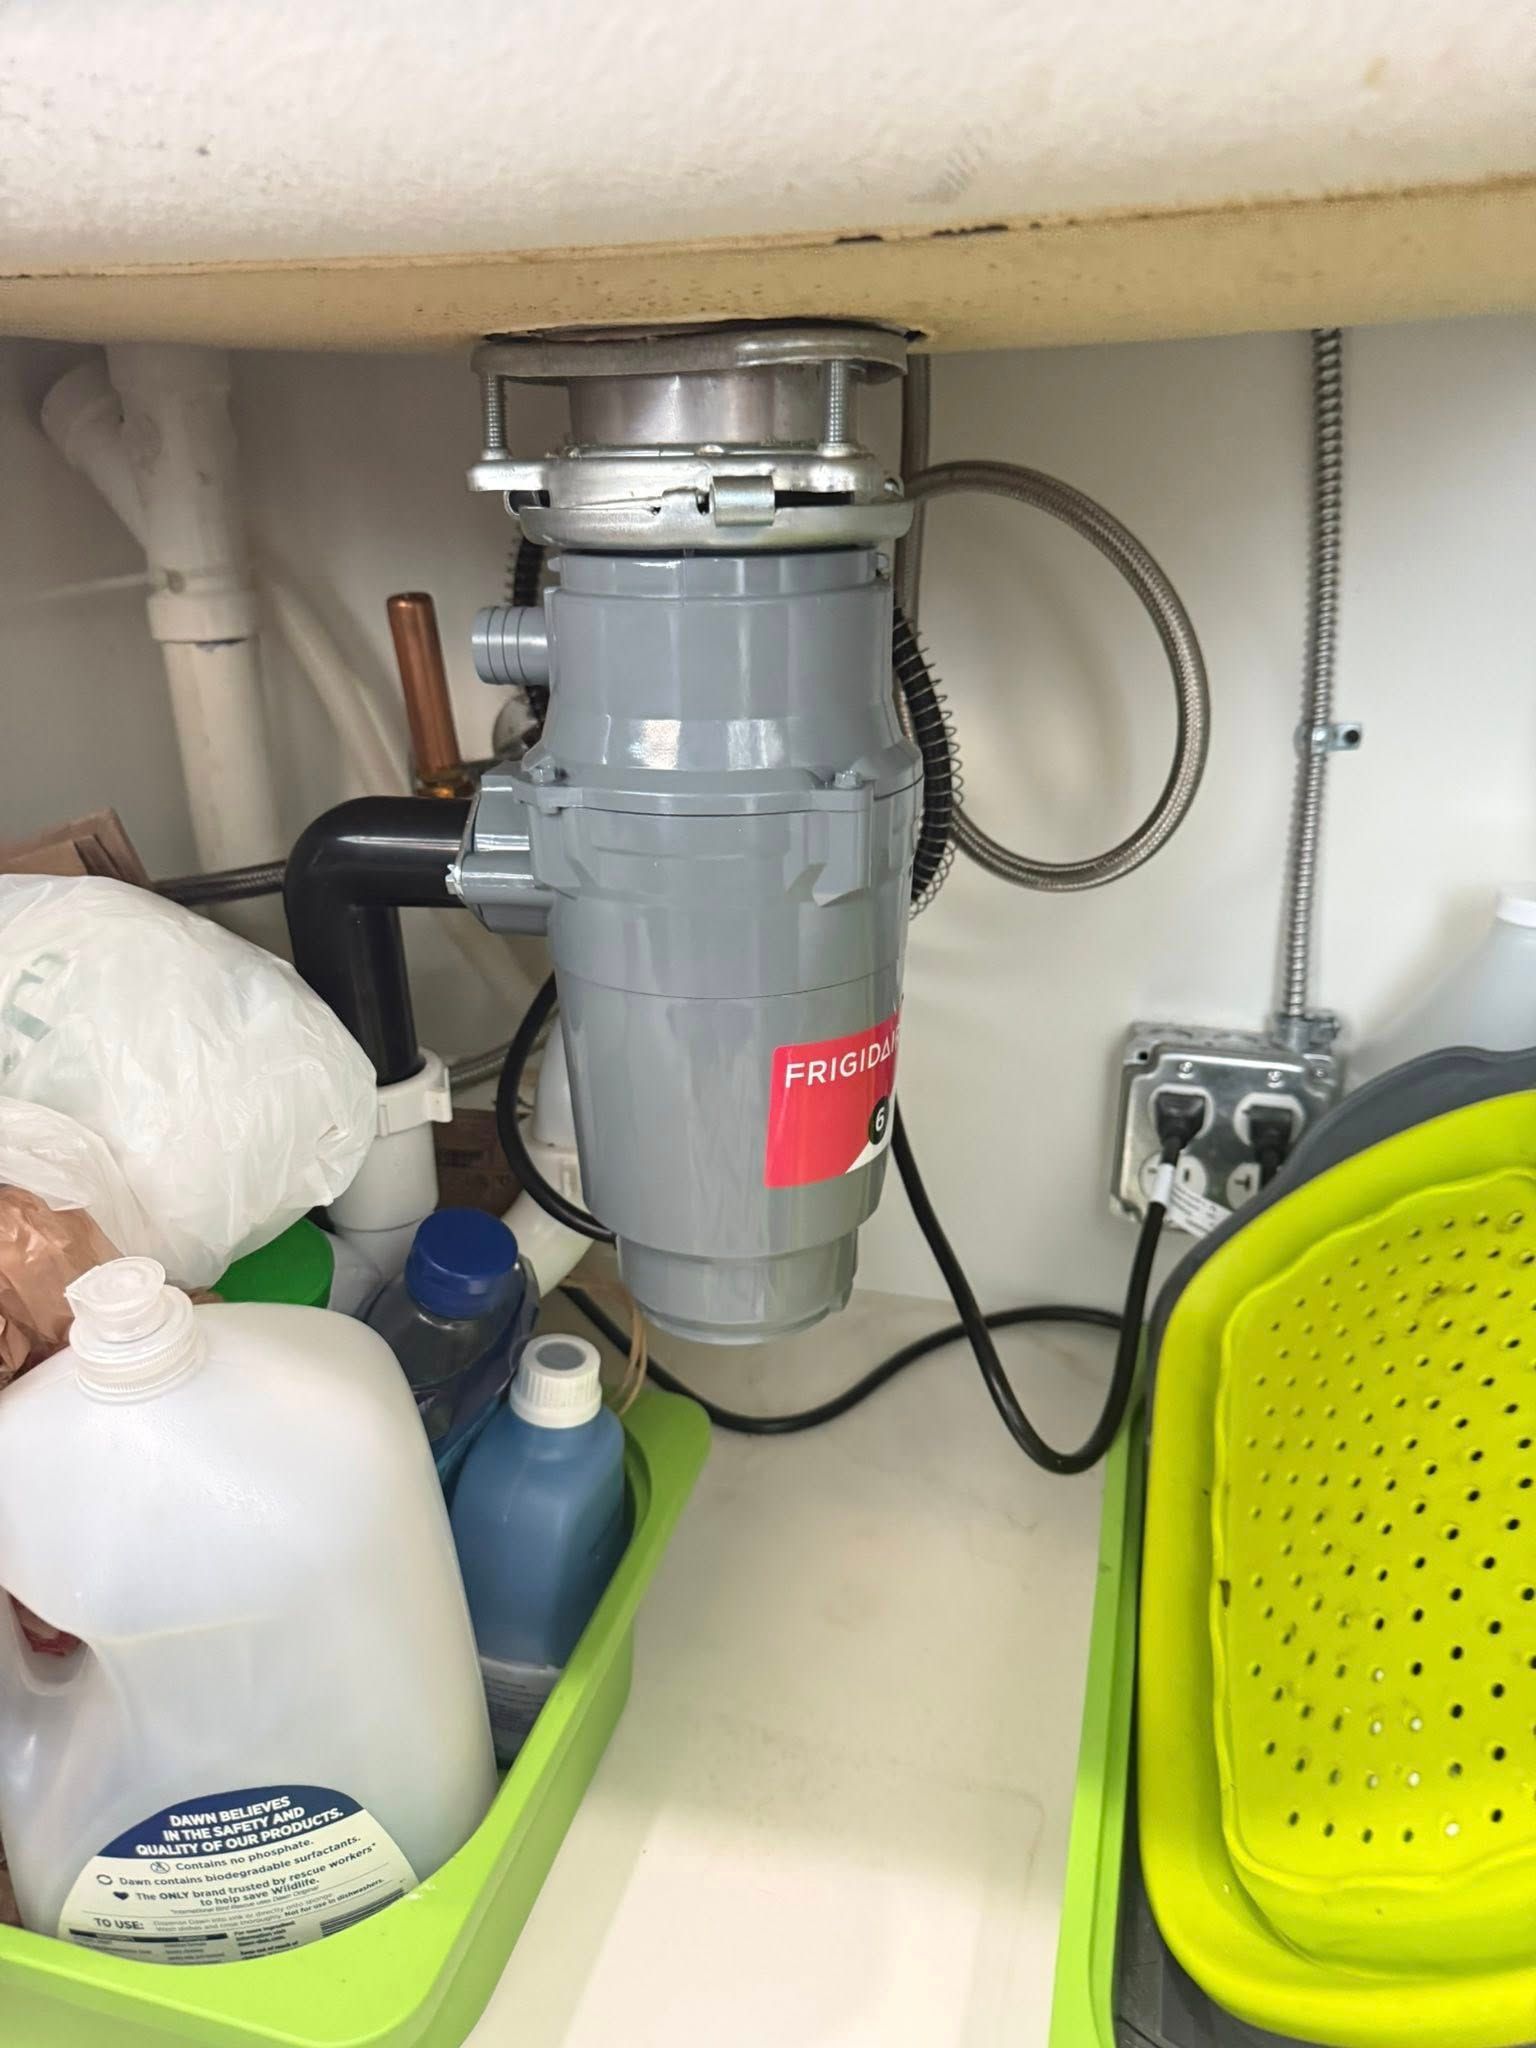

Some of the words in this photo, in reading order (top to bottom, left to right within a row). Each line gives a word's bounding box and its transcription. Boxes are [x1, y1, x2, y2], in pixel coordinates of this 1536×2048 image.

[875, 1106, 885, 1132] 6
[162, 1830, 180, 1841] IN
[181, 1828, 211, 1840] THE
[213, 1816, 269, 1837] SAFETY
[272, 1807, 305, 1824] AND
[169, 1812, 217, 1827] DAWN
[219, 1796, 291, 1822] BELIEVES
[135, 1843, 198, 1856] QUALITY
[202, 1840, 223, 1852] OF
[225, 1834, 259, 1849] OUR
[261, 1808, 344, 1842] PRODUCTS.
[119, 1877, 152, 1886] Dawn
[154, 1875, 203, 1886] contains
[205, 1860, 291, 1881] biodegradable
[294, 1835, 361, 1864] surfactants.
[176, 1858, 227, 1870] Contains
[230, 1857, 246, 1865] no
[249, 1840, 314, 1863] phosphate.
[136, 1892, 156, 1900] The
[160, 1891, 189, 1900] ONLY
[193, 1888, 226, 1898] brand
[229, 1882, 270, 1894] trusted
[272, 1877, 286, 1887] by
[290, 1865, 326, 1880] rescue
[200, 1899, 213, 1907] to
[215, 1896, 240, 1906] help
[243, 1891, 268, 1900] save
[271, 1877, 319, 1895] Wildlife.
[94, 1917, 111, 1927] TO
[114, 1920, 144, 1930] USE:
[284, 1908, 299, 1917] Not
[300, 1904, 311, 1913] for
[313, 1901, 326, 1909] use
